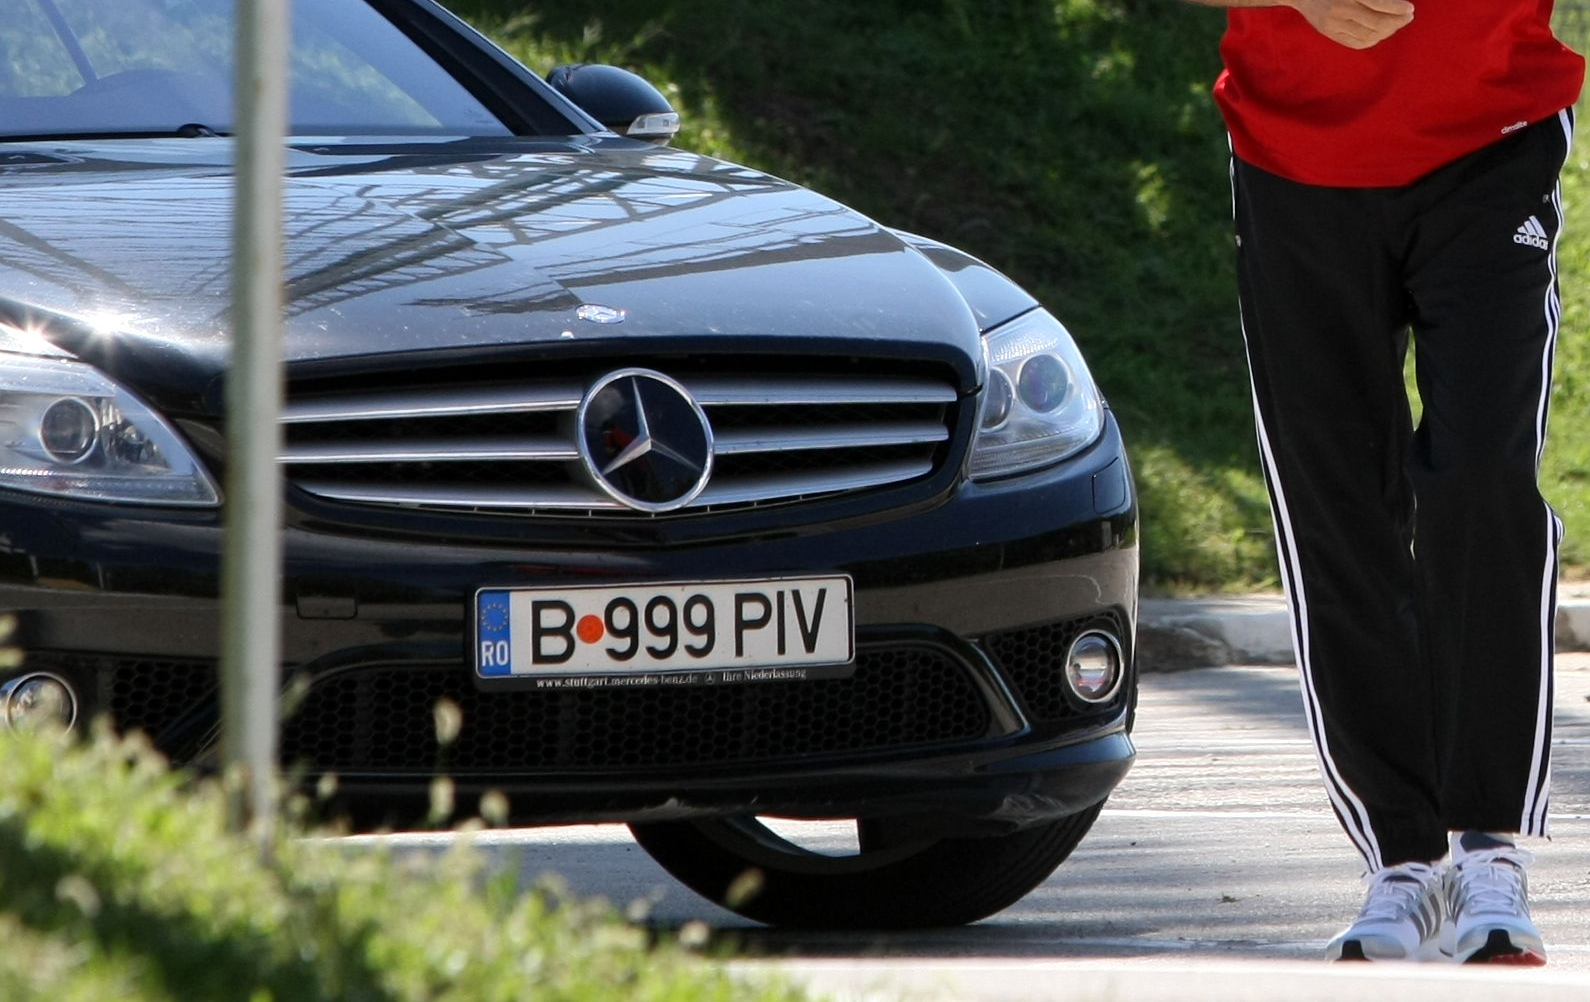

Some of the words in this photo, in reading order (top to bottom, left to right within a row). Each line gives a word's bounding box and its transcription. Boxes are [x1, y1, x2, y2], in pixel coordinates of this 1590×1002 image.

[1513, 232, 1549, 251] adidas
[530, 600, 576, 665] B
[604, 594, 716, 662] 999
[734, 588, 828, 657] PIV
[481, 639, 510, 666] RO
[722, 671, 742, 682] Ihre
[744, 668, 807, 680] Niederlassung
